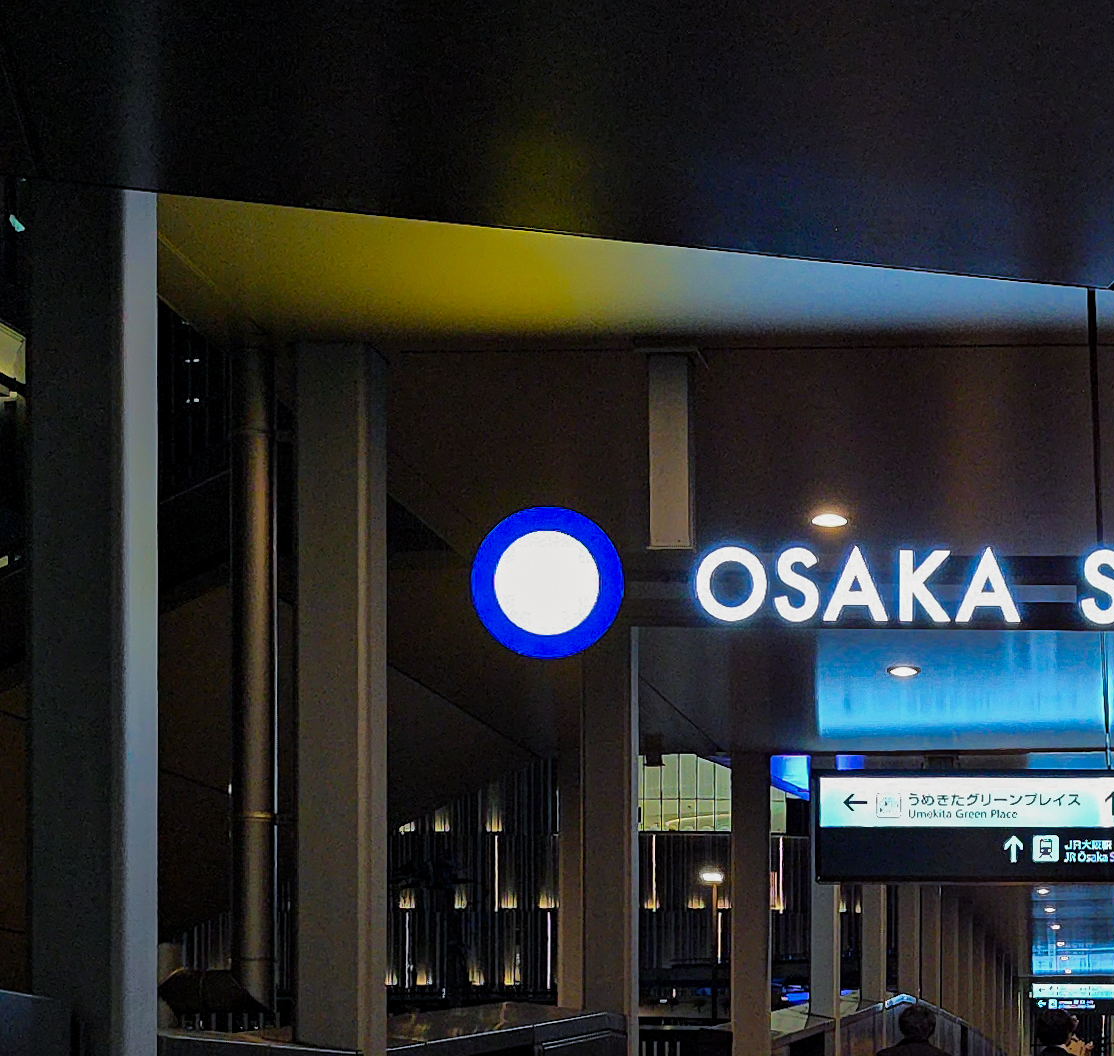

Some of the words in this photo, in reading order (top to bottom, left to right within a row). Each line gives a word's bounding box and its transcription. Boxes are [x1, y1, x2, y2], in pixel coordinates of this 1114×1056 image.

[696, 545, 1021, 623] OSAKA
[908, 792, 1081, 807] うめきたグリーンプレイス
[908, 809, 952, 819] Umekita
[955, 809, 987, 819] Green
[990, 809, 1019, 819] Place
[1063, 852, 1077, 863] JR
